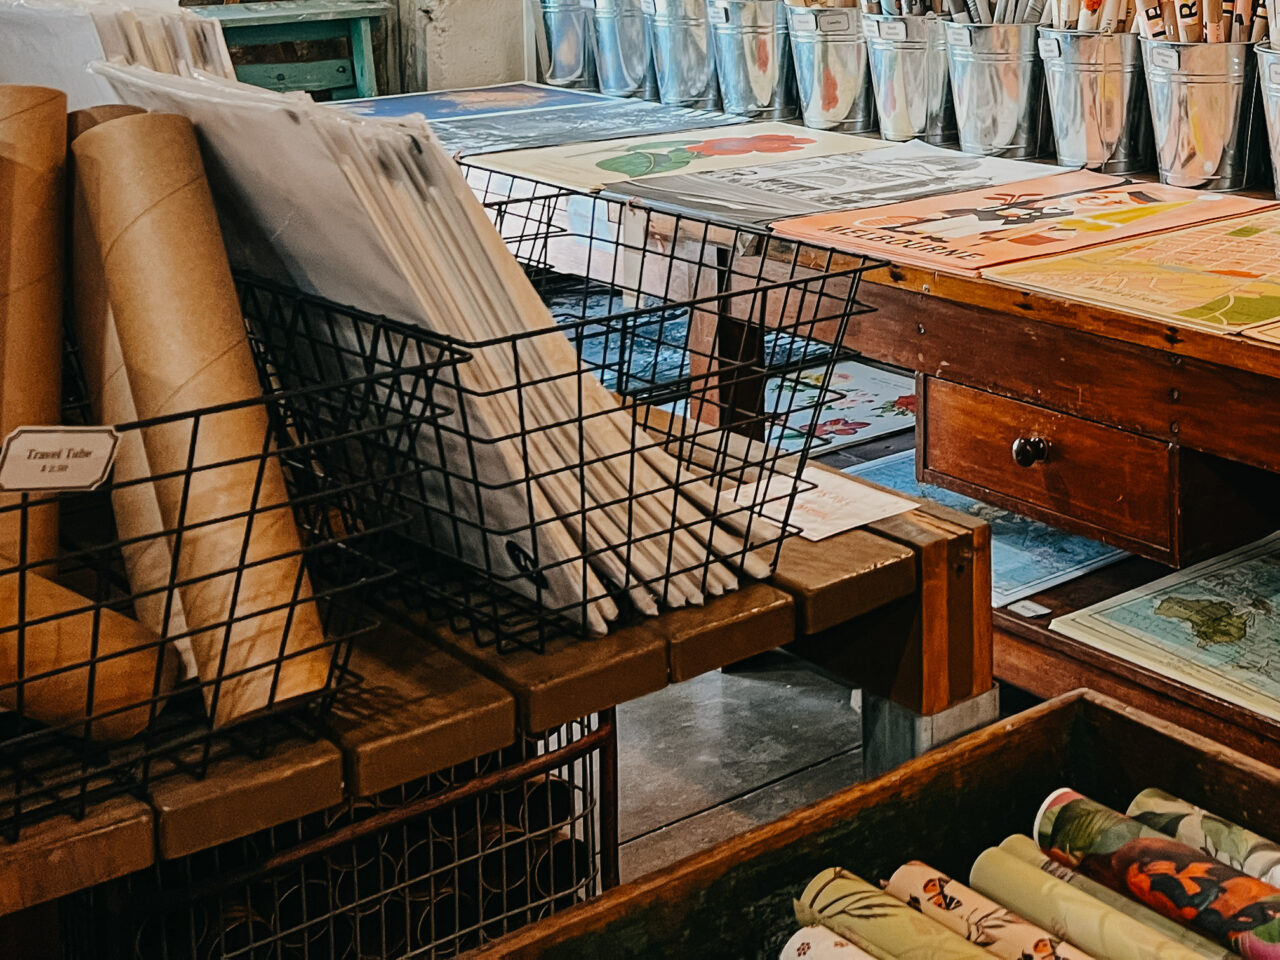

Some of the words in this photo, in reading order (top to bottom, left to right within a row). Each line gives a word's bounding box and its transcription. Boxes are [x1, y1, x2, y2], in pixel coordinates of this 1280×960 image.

[818, 225, 985, 261] MELBOURNE
[27, 448, 62, 459] Travel
[66, 448, 93, 459] Tube
